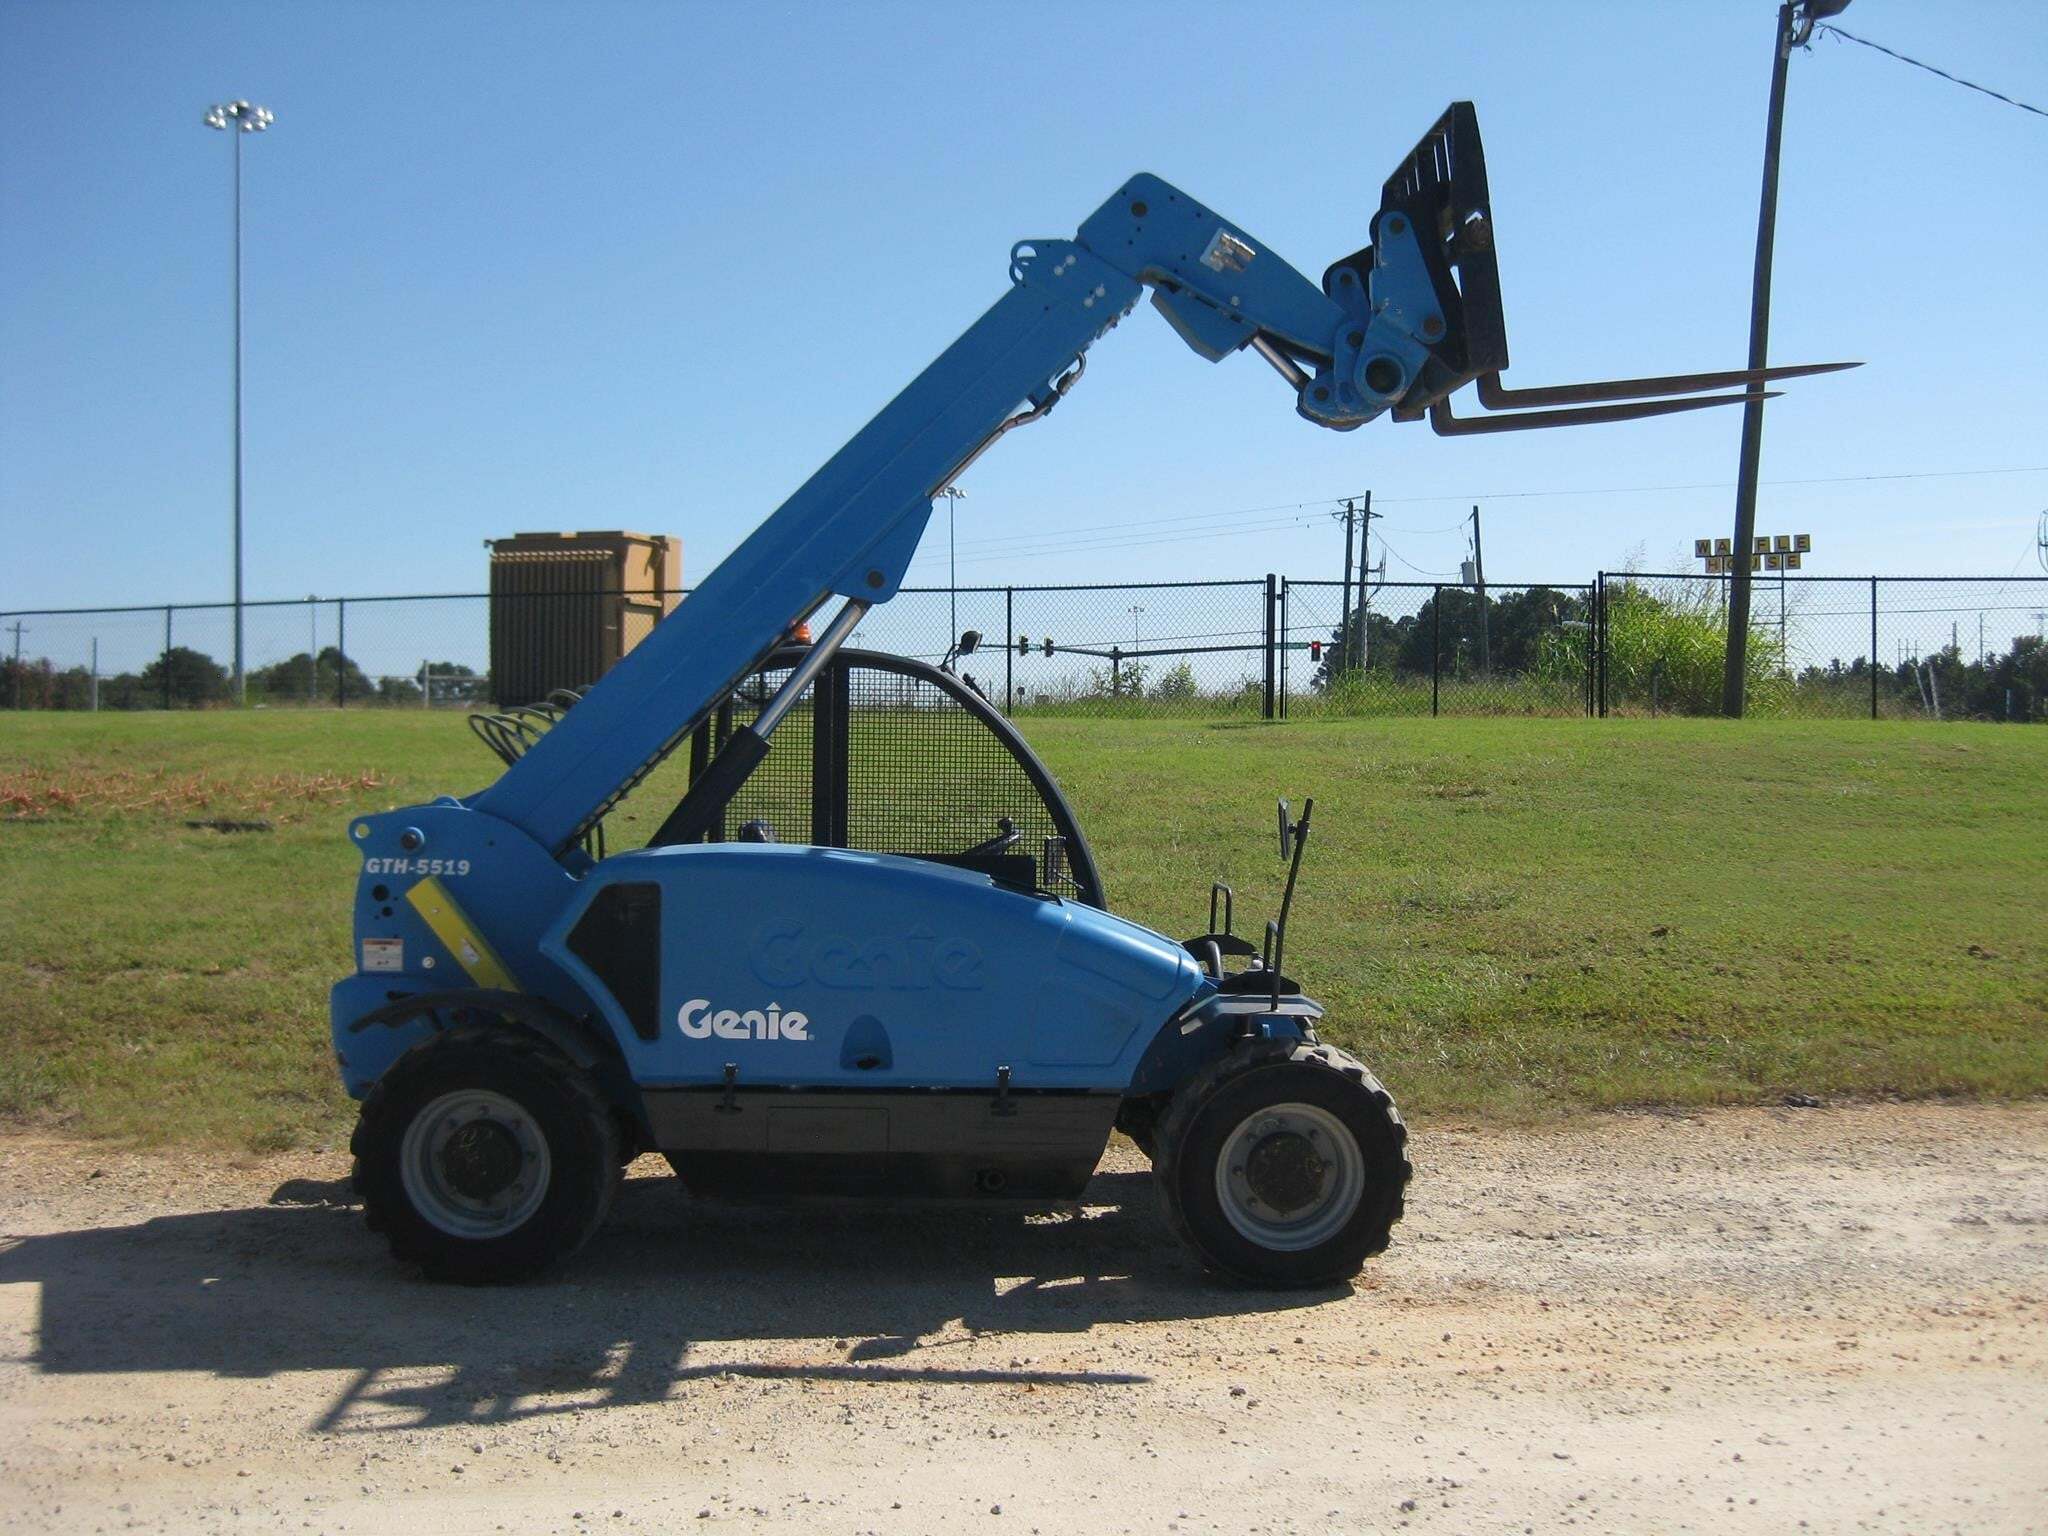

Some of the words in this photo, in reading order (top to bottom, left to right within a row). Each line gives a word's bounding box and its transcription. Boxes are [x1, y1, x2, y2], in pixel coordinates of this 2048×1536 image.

[1697, 536, 1807, 553] WAFLE
[365, 858, 471, 876] GTH-5519
[750, 919, 985, 990] Genie
[677, 998, 809, 1041] Genie
